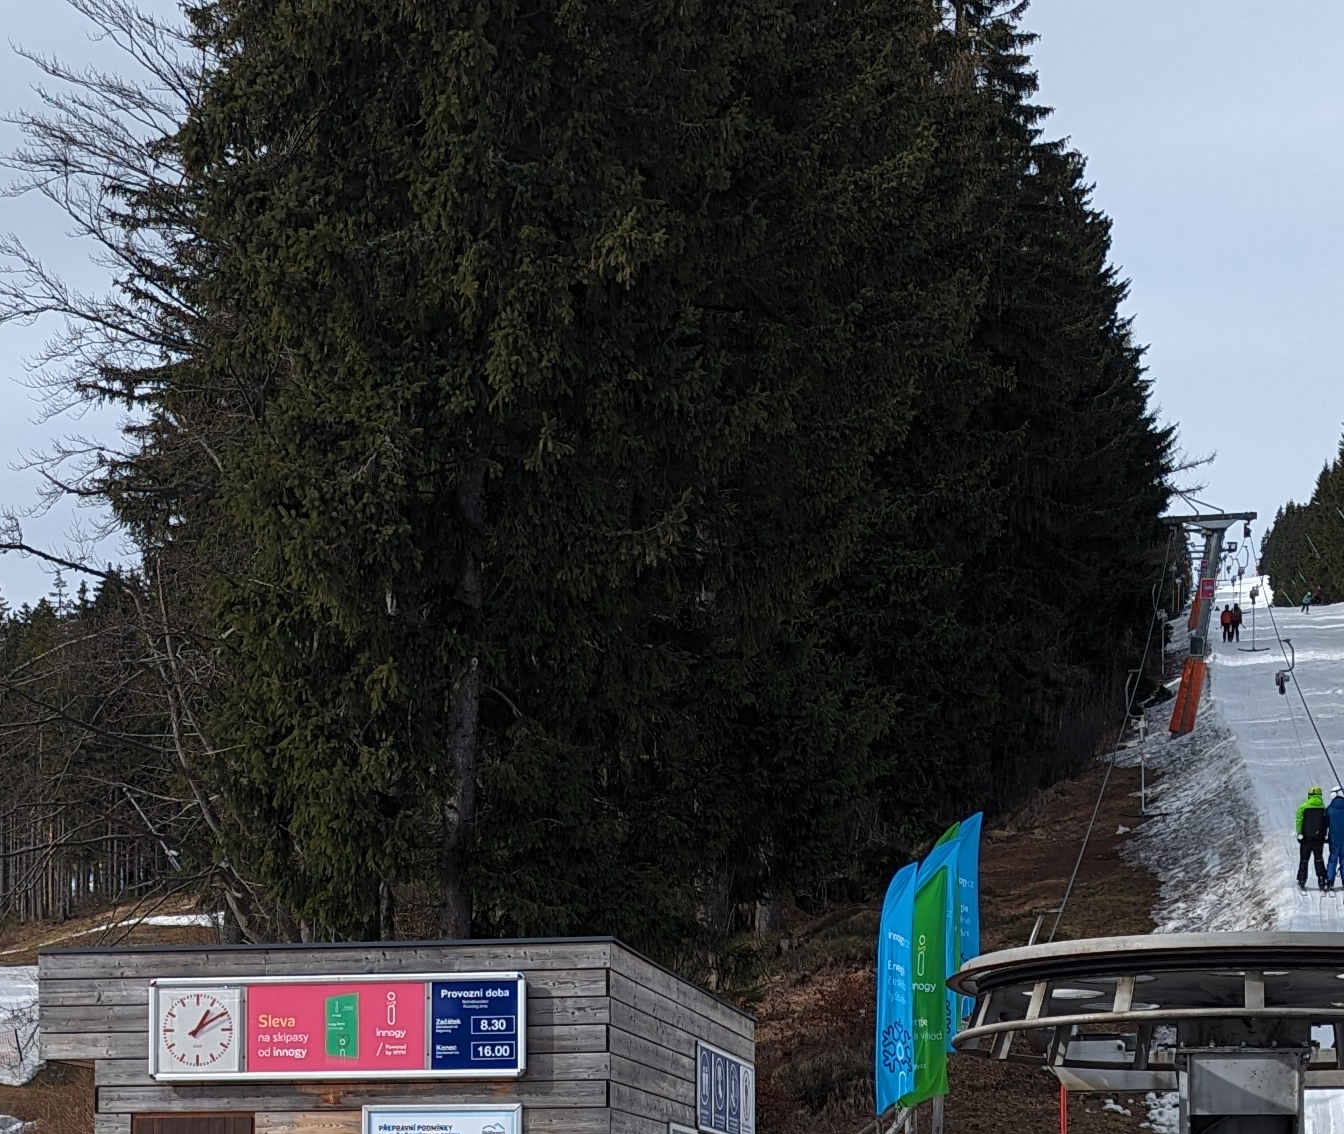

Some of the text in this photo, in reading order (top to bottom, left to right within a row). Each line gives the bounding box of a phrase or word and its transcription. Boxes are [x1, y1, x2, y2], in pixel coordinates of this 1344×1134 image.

[440, 988, 510, 999] Provozní doba
[258, 1014, 296, 1028] Sleva
[480, 1019, 507, 1030] 8.30
[258, 1032, 309, 1045] na skipasy
[376, 1028, 407, 1039] innogy
[258, 1047, 308, 1059] od innogy
[477, 1045, 510, 1057] 16.00
